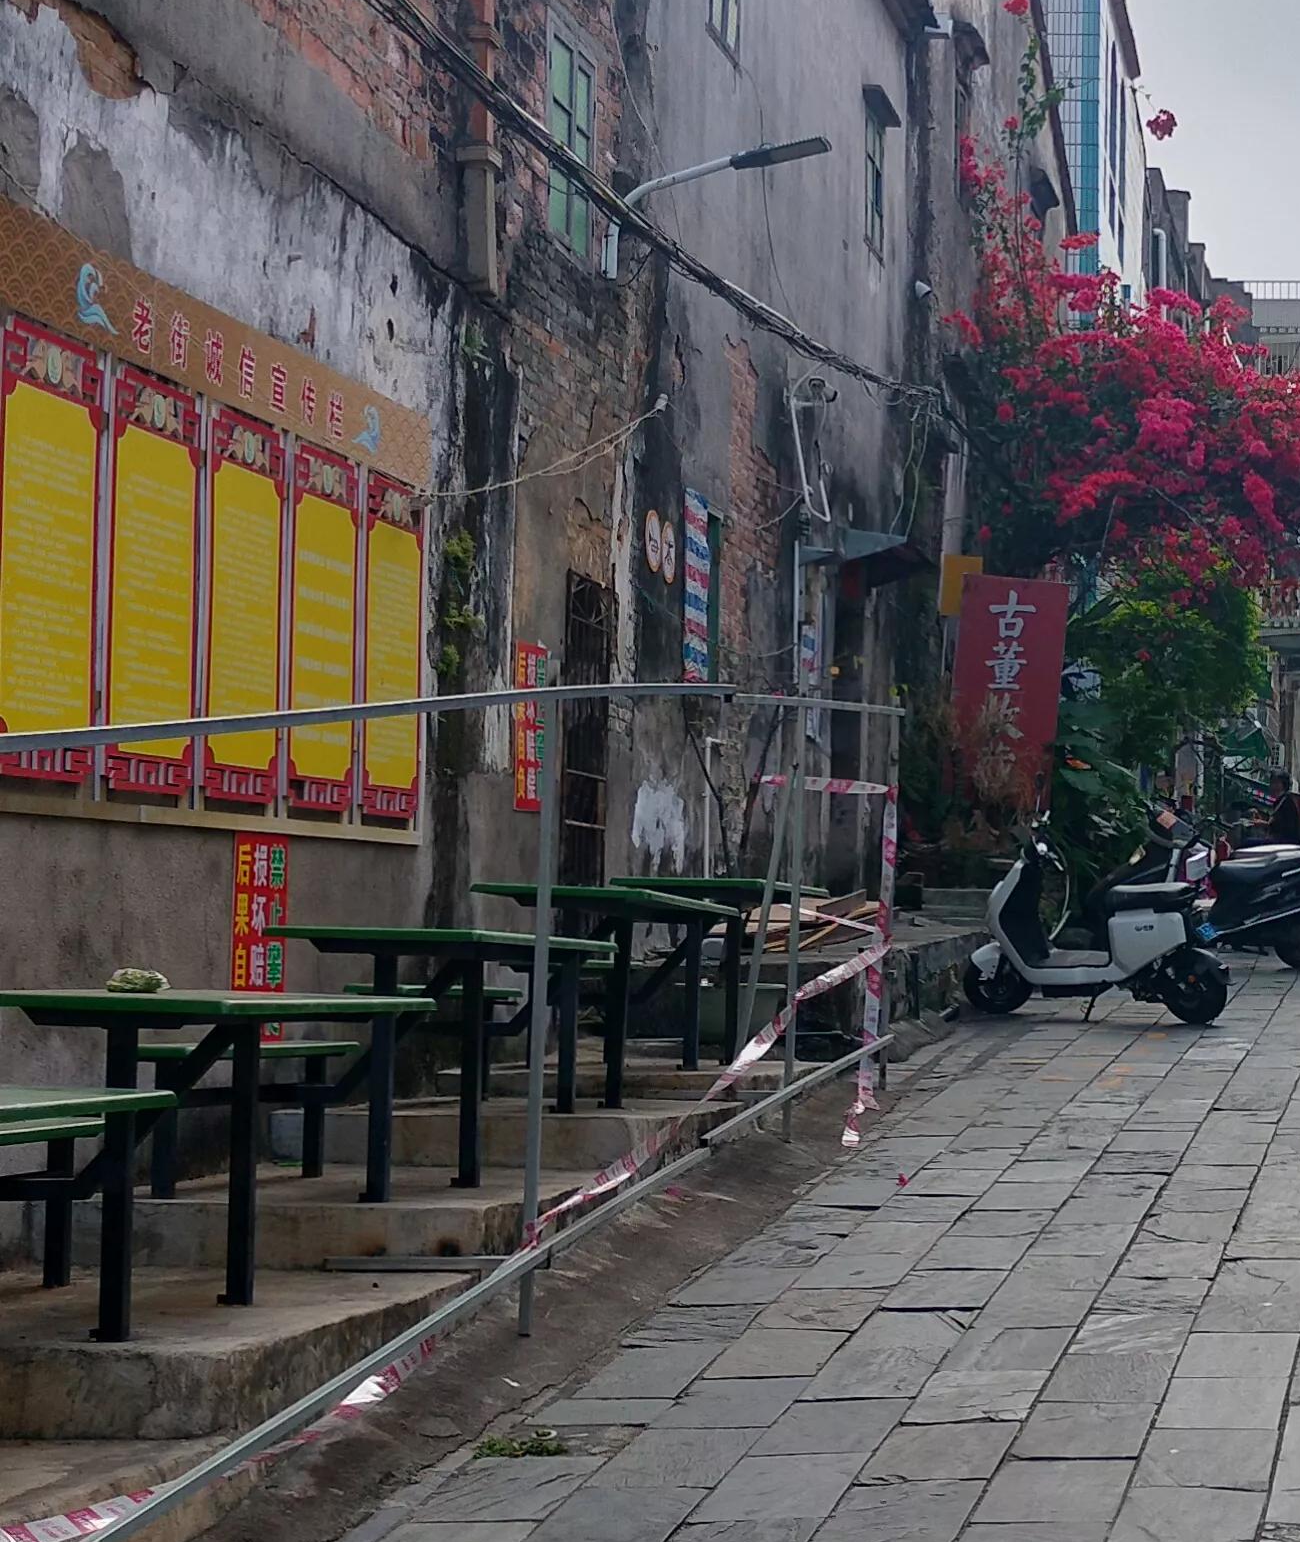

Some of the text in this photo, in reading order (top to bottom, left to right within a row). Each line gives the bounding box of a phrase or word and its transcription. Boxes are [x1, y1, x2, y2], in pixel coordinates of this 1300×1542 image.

[132, 296, 344, 440] 老街诚信宣传栏
